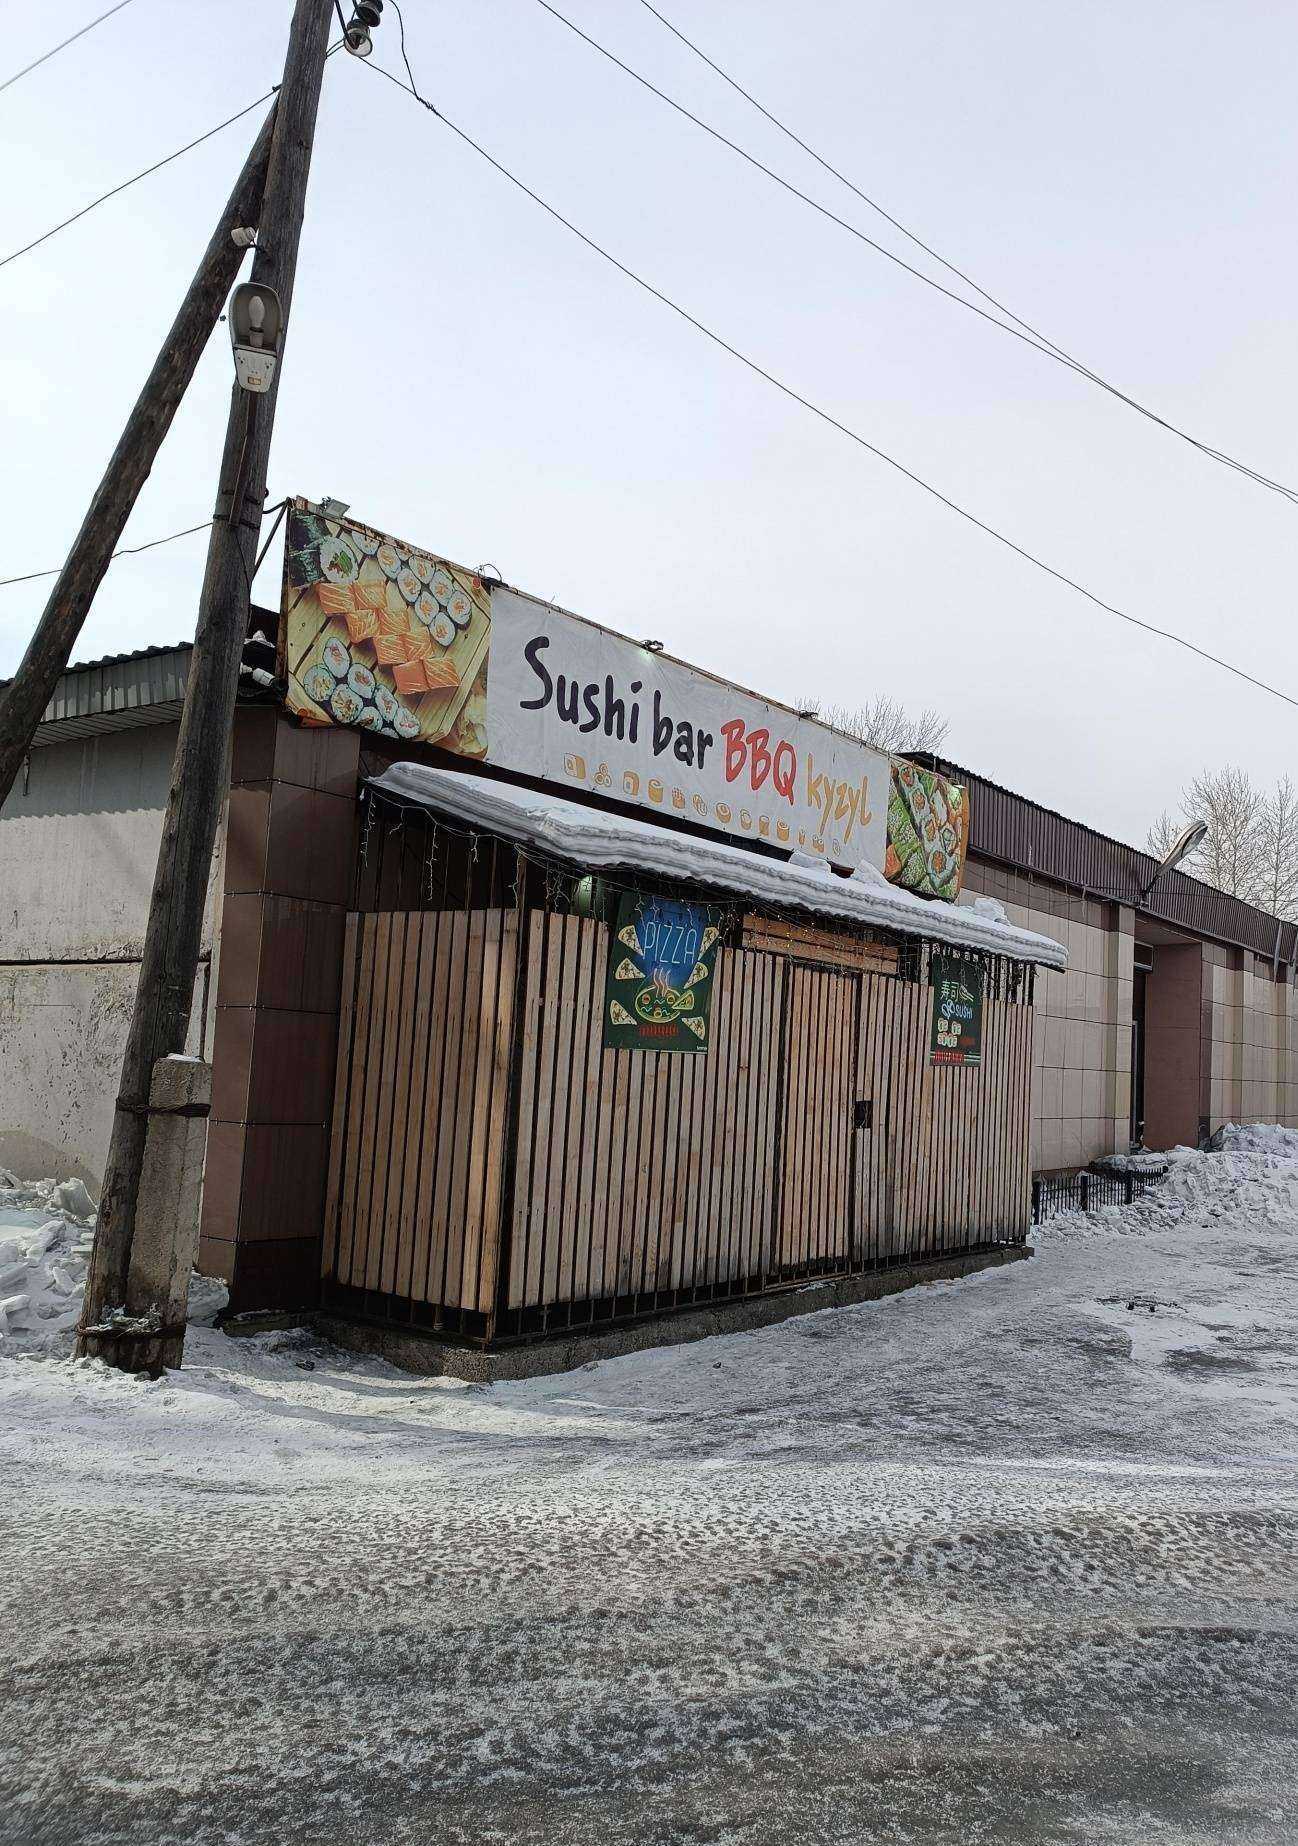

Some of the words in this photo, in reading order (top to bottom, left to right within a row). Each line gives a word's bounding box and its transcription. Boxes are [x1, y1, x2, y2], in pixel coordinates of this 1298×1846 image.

[520, 636, 643, 743] Sushi
[653, 690, 713, 769] bar
[720, 718, 798, 806] BBQ
[807, 752, 872, 844] kyzyl
[643, 921, 698, 965] PIZZA
